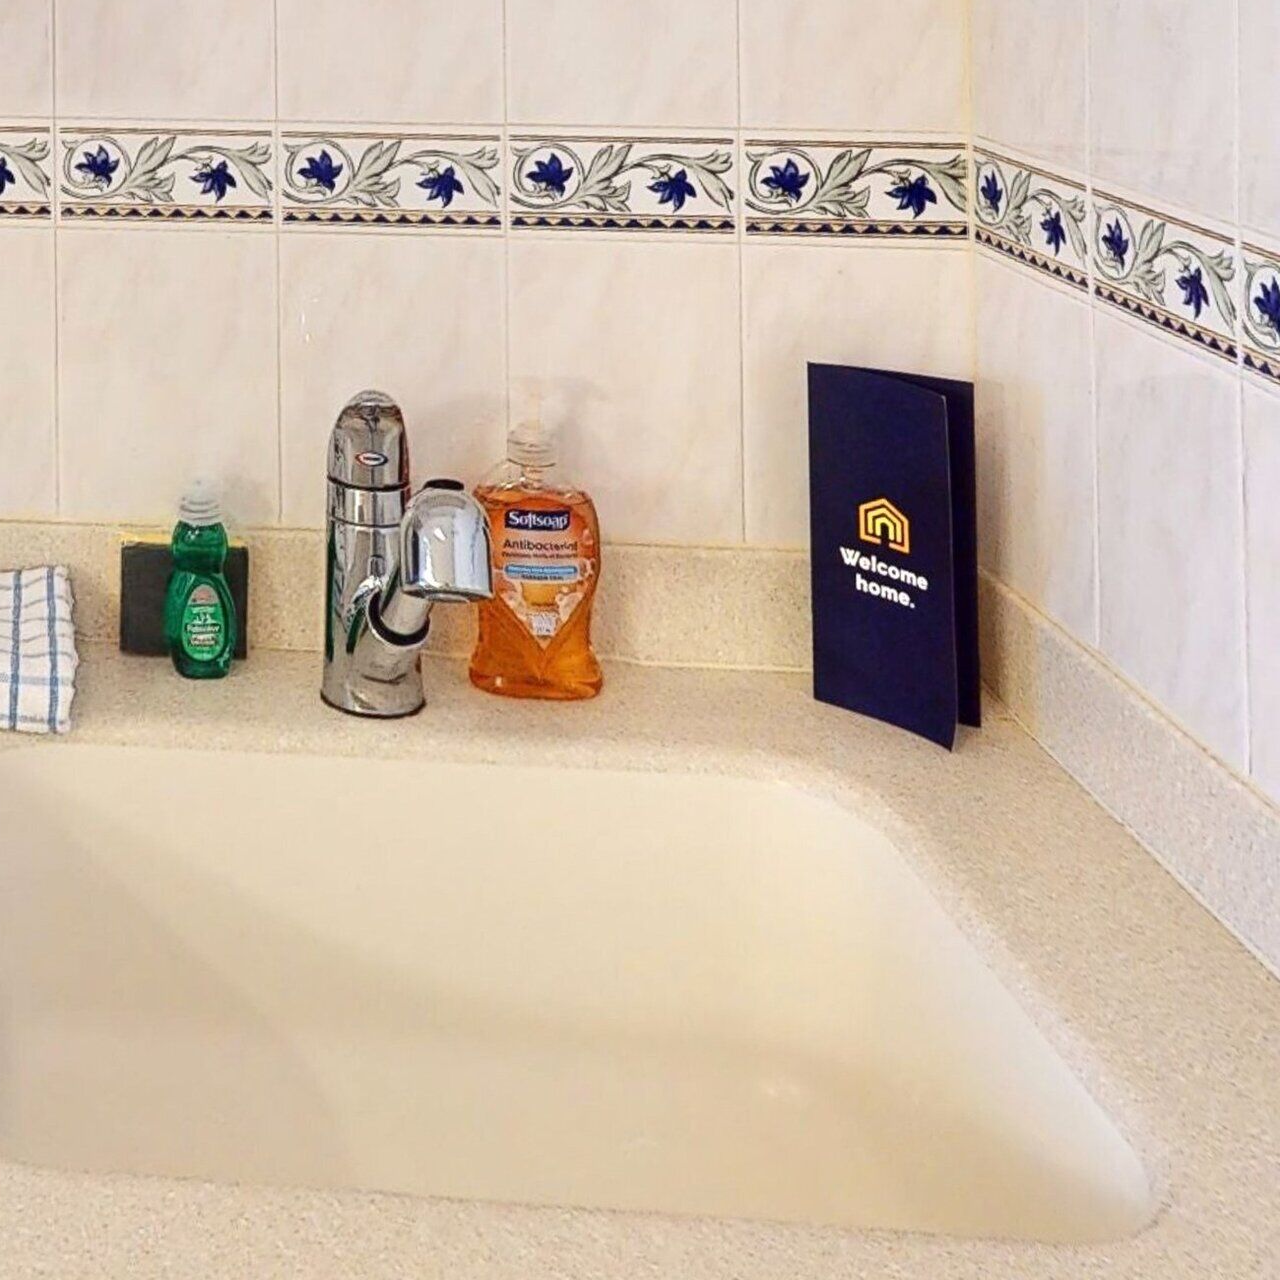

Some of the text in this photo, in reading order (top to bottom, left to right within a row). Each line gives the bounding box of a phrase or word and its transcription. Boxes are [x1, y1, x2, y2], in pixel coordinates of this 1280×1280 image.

[508, 510, 569, 529] Softsoap
[840, 546, 929, 591] Welcome
[855, 572, 916, 609] home.
